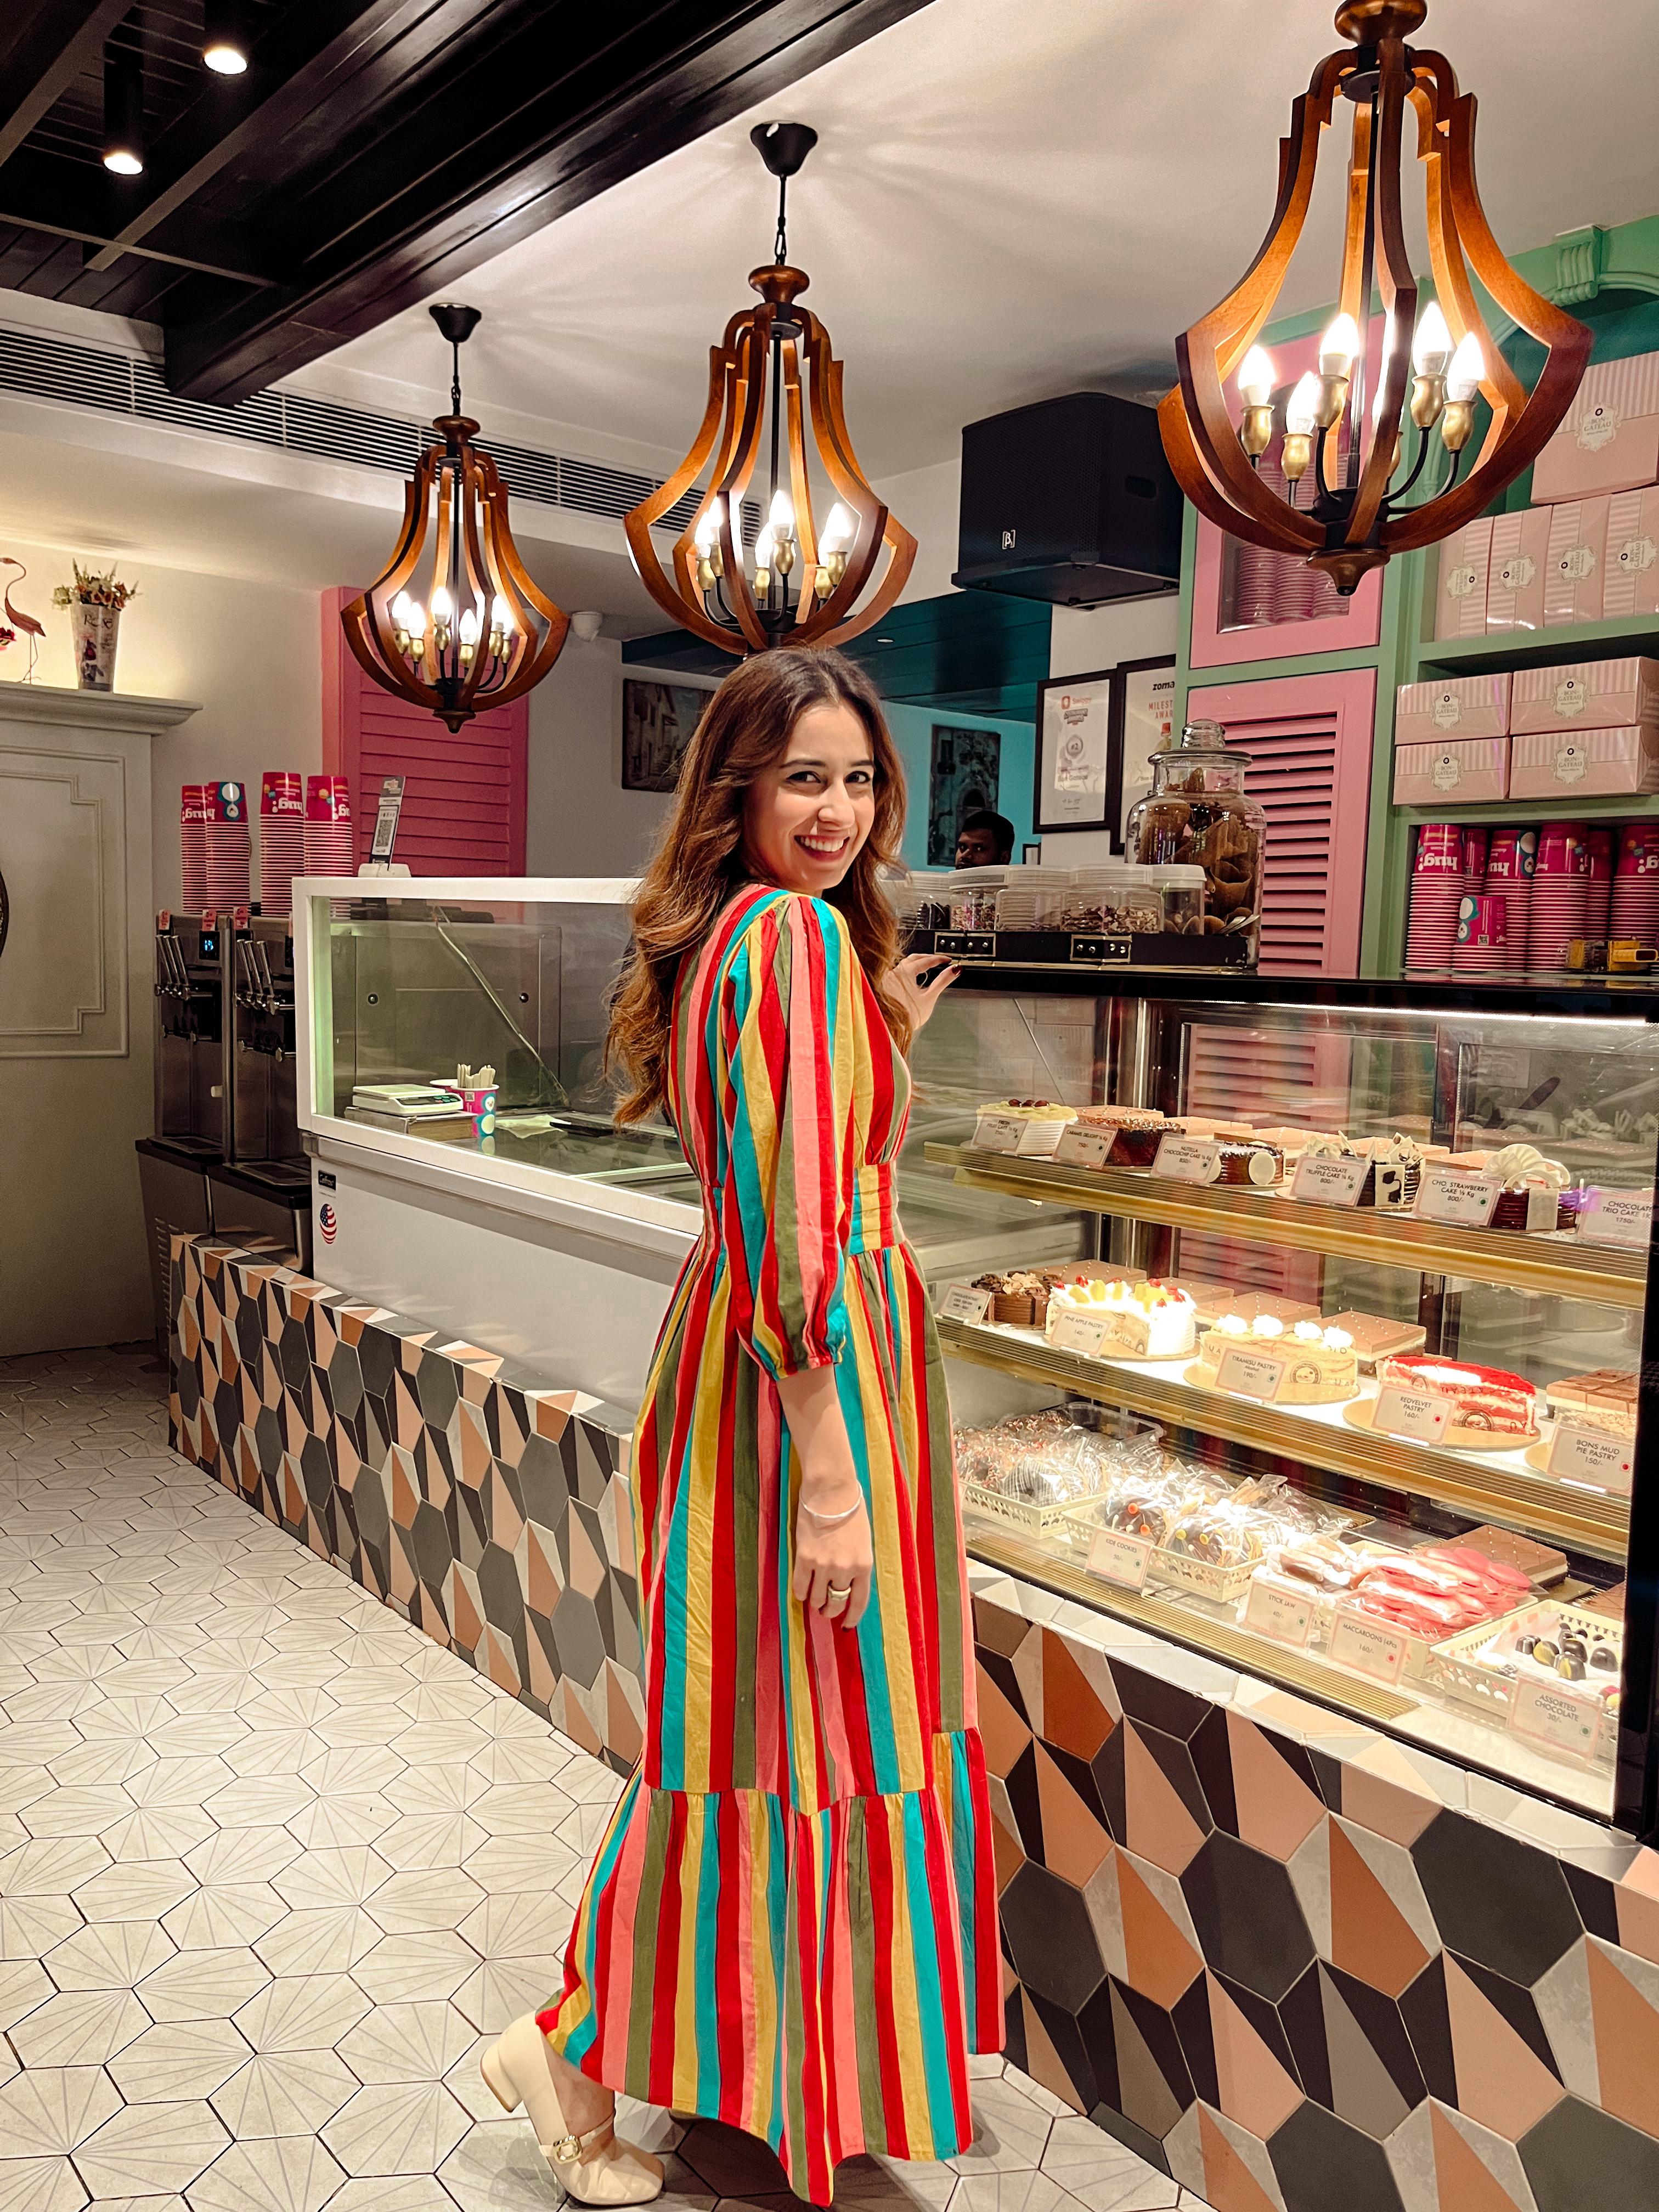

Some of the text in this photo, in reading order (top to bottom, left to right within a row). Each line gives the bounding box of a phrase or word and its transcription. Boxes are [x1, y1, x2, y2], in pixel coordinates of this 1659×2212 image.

[1316, 1164, 1348, 1173] CHOCOLATE
[1449, 1182, 1489, 1193] STRAWBERRY
[1621, 1209, 1640, 1217] CAKE
[1088, 1321, 1104, 1329] PASTRY
[1232, 1355, 1277, 1370] TIRAMISU PASTRY
[1400, 1396, 1432, 1408] REDVELVET
[1403, 1404, 1425, 1413] PASTRY
[1576, 1439, 1620, 1455] BONS MUD
[1576, 1446, 1617, 1462] PIE PASTRY
[1585, 1456, 1604, 1466] 150/-
[1116, 1542, 1137, 1553] COOKIES
[1268, 1594, 1283, 1604] STICK
[1343, 1623, 1383, 1643] MACCAROONS
[1539, 1694, 1576, 1712] ASSORTED
[1534, 1700, 1579, 1722] CHOCOLATE
[1547, 1713, 1562, 1723] 30/-
